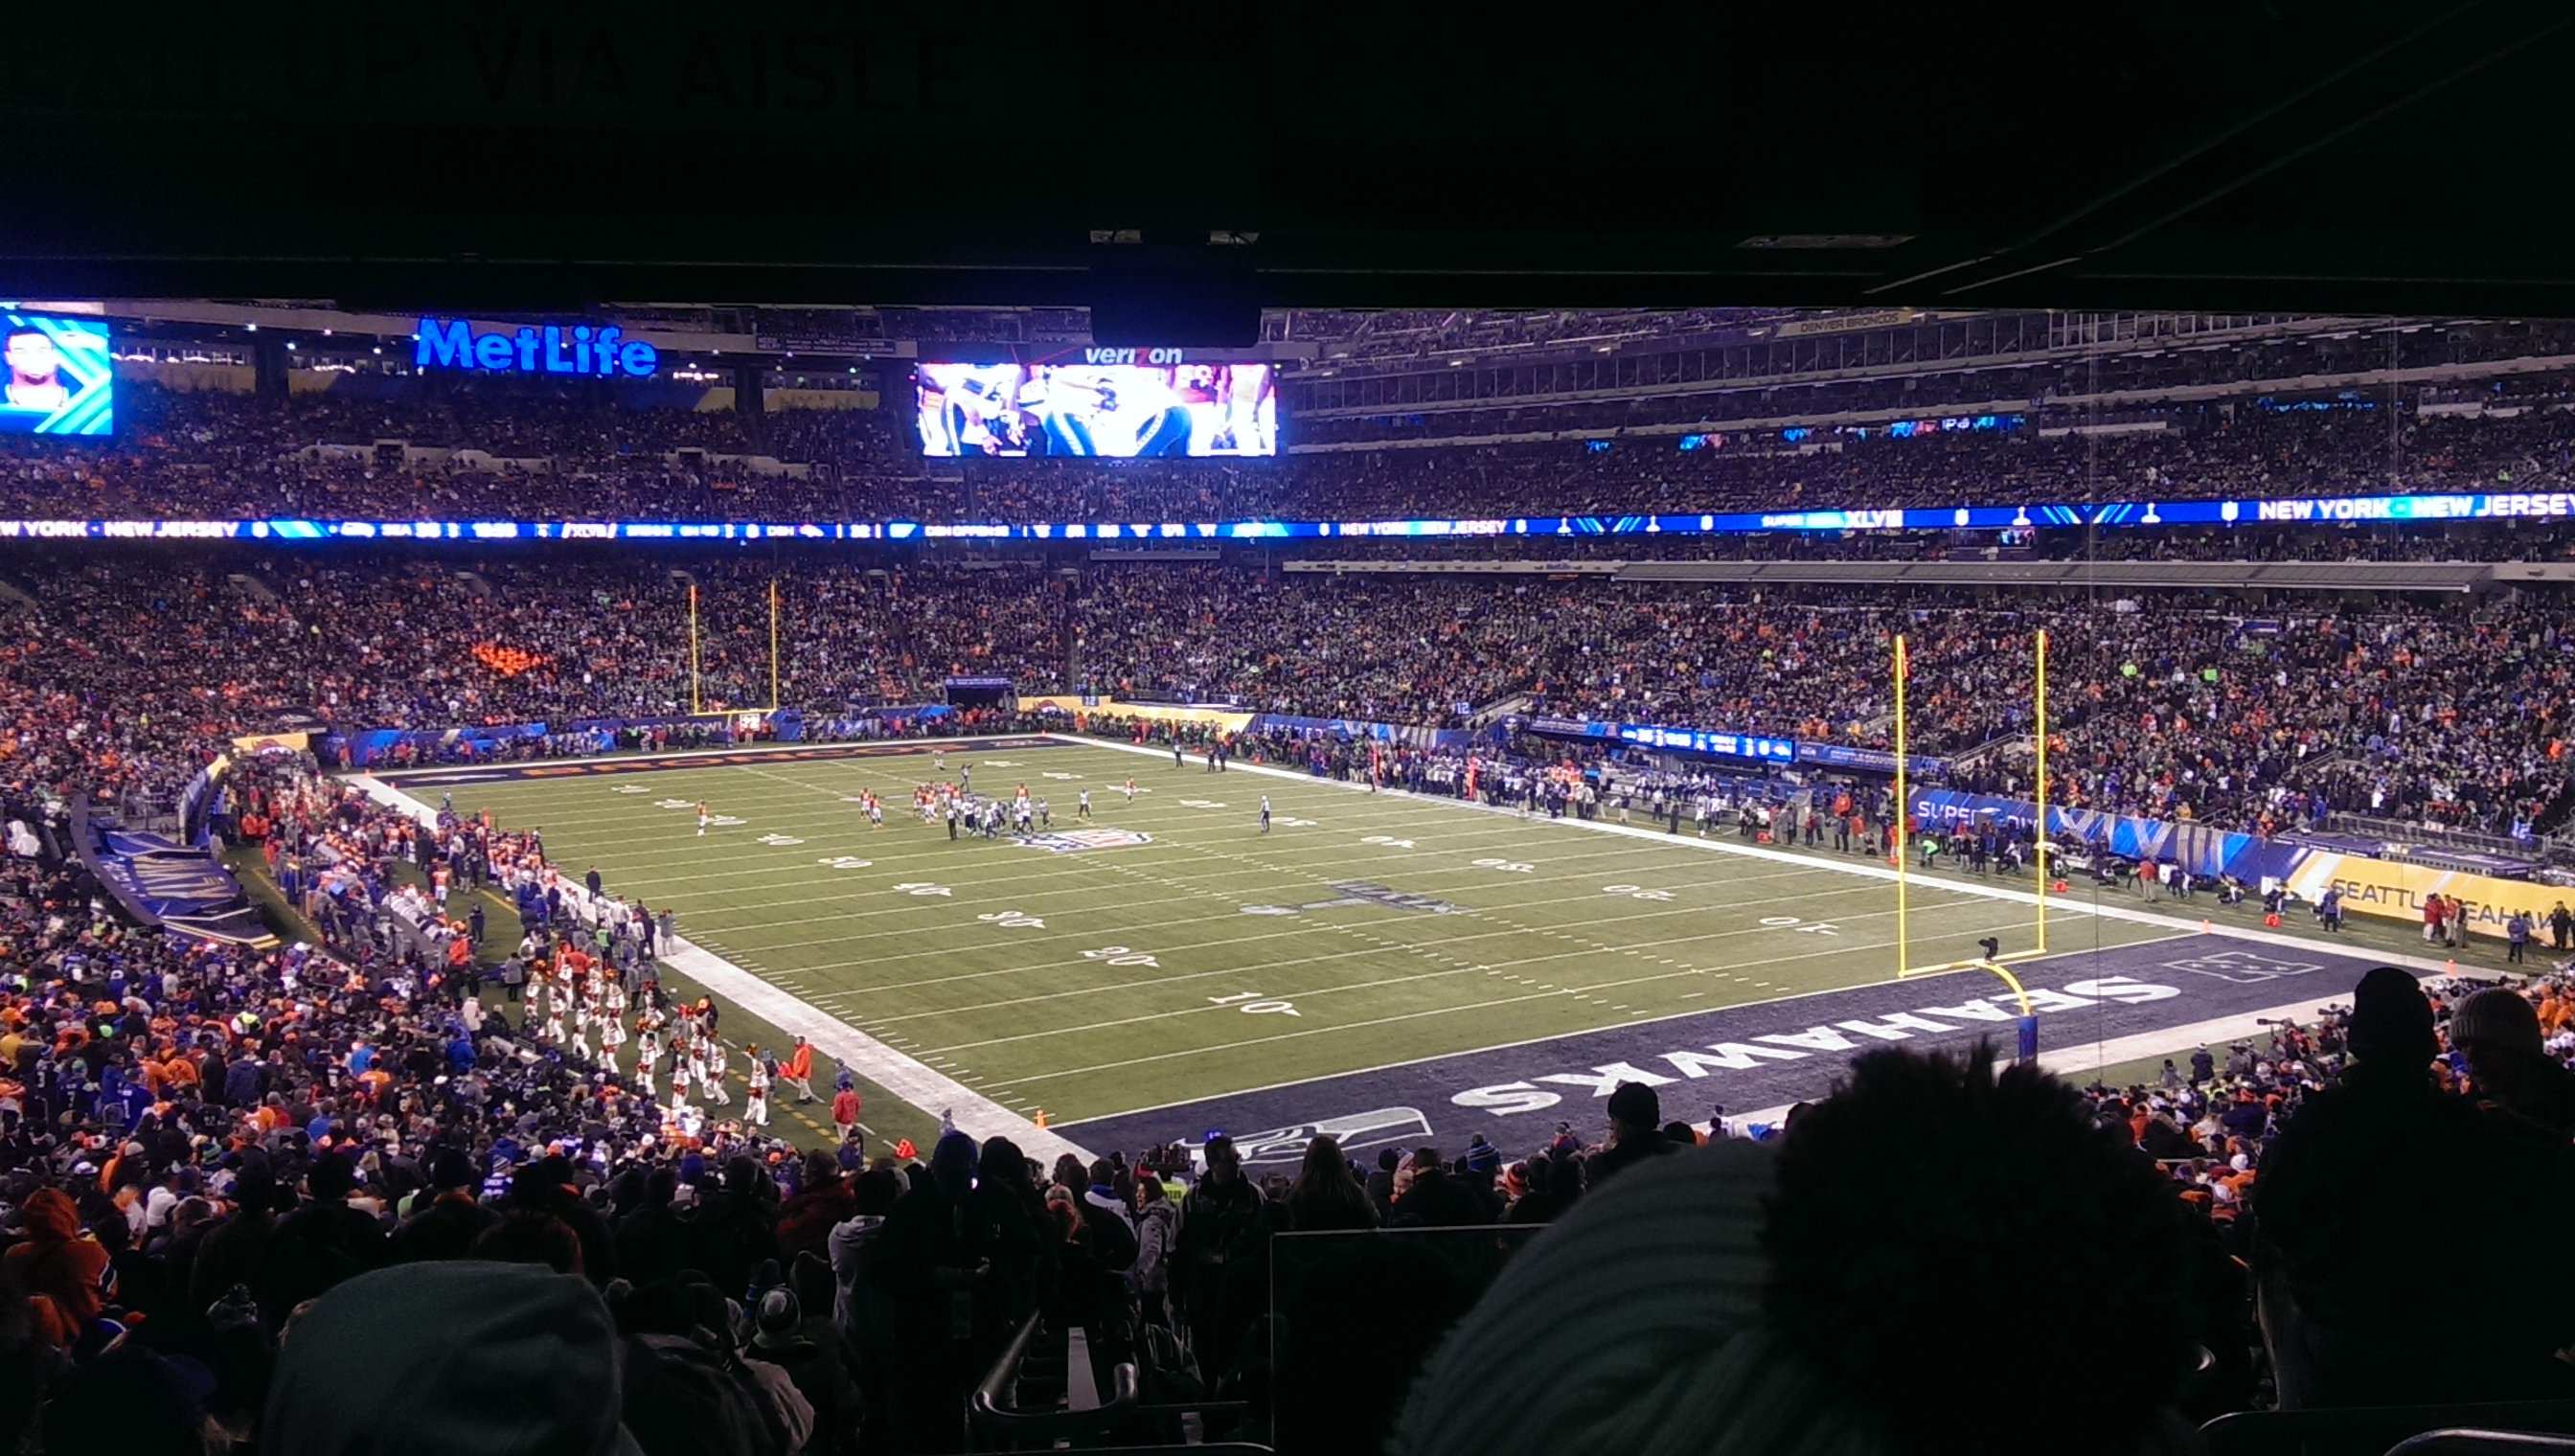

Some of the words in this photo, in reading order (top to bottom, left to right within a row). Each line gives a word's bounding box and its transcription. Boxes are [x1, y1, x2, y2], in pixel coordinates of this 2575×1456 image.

[1801, 318, 1844, 332] DENVER
[1846, 312, 1900, 328] BRONCOS
[416, 318, 657, 375] MetLife
[1085, 347, 1183, 366] verizon
[2260, 501, 2313, 519] NEW
[2318, 498, 2390, 518] YORK
[2412, 497, 2472, 517] NEW
[23, 521, 87, 536] YORK
[104, 521, 152, 536] NEW
[156, 521, 238, 536] JERSEY
[1339, 522, 1370, 535] NEW
[1372, 521, 1410, 535] YORK
[1420, 521, 1450, 535] NEW
[1452, 520, 1507, 535] JERSEY
[1456, 702, 1470, 715] 12
[1602, 884, 1677, 902] 20
[2330, 876, 2426, 911] SEATTL
[978, 911, 1042, 928] 30
[1759, 916, 1839, 936] 10
[1083, 946, 1155, 967] 20
[1207, 990, 1293, 1015] 10
[1450, 974, 2181, 1117] SEAHAWKS
